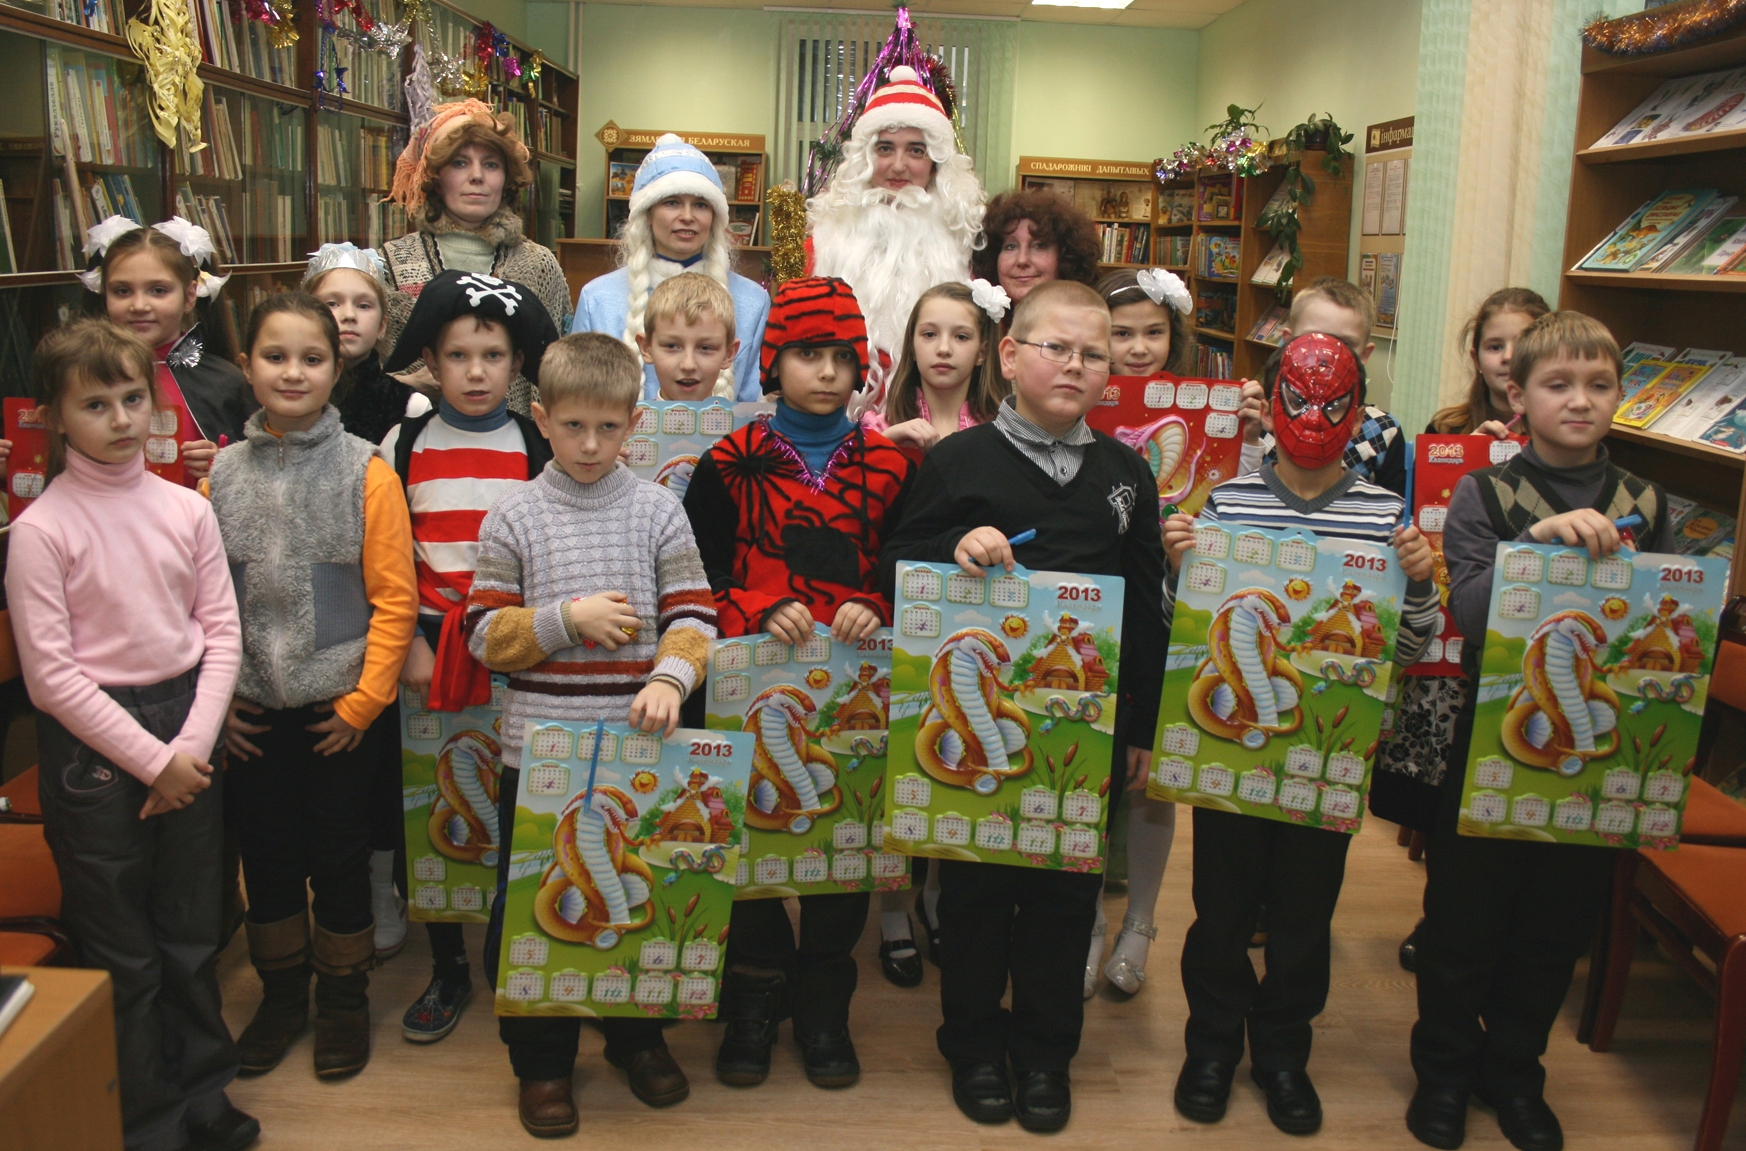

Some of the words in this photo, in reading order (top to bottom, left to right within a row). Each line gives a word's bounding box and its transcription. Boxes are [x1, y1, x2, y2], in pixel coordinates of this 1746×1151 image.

[689, 137, 750, 147] БЕЛАРУСКАЯ
[1031, 162, 1091, 172] СПАДАРОЖНІКІ
[1096, 166, 1149, 175] ДАПЫТЛІВЫХ
[1429, 444, 1464, 457] 2013
[1343, 554, 1387, 572] 2013
[1660, 568, 1704, 584] 2013
[1058, 586, 1101, 602] 2013
[690, 742, 732, 757] 2013
